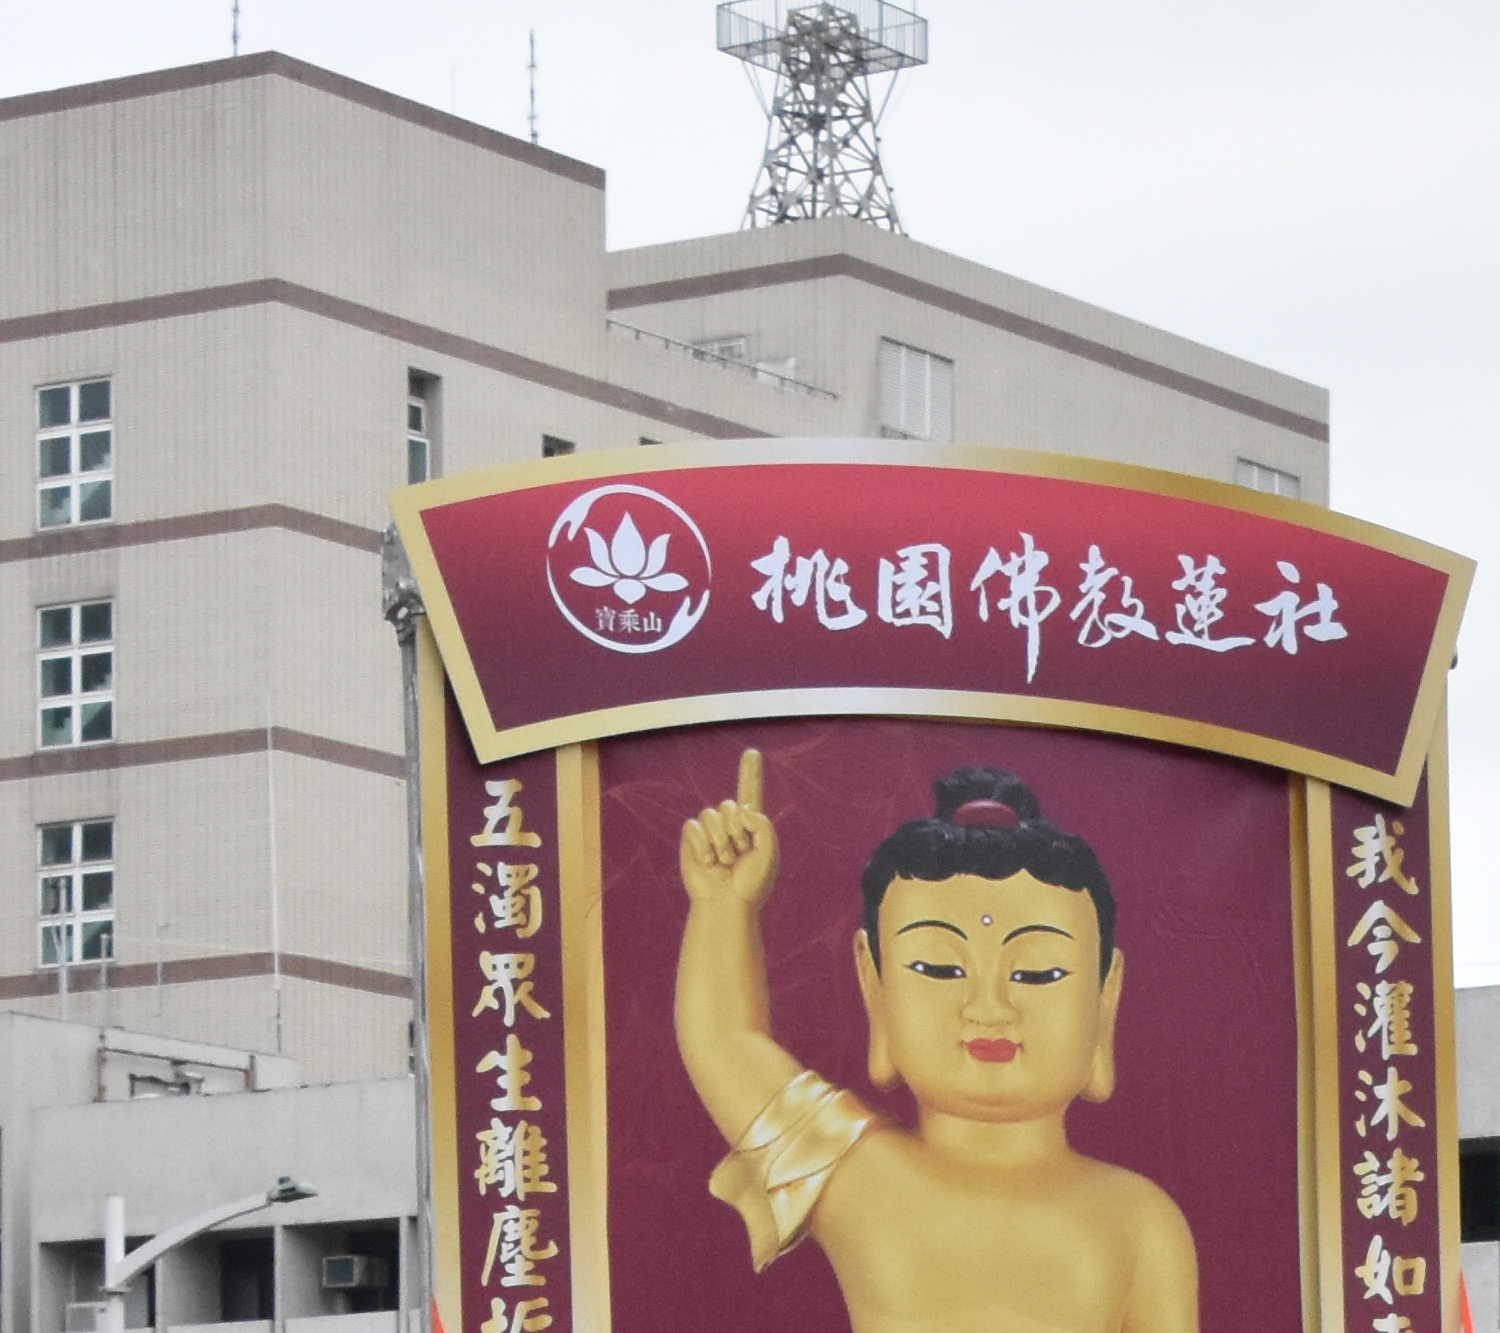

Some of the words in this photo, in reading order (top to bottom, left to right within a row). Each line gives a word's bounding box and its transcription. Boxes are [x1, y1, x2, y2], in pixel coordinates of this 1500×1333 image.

[748, 532, 1349, 686] 桃園佛教蓮社
